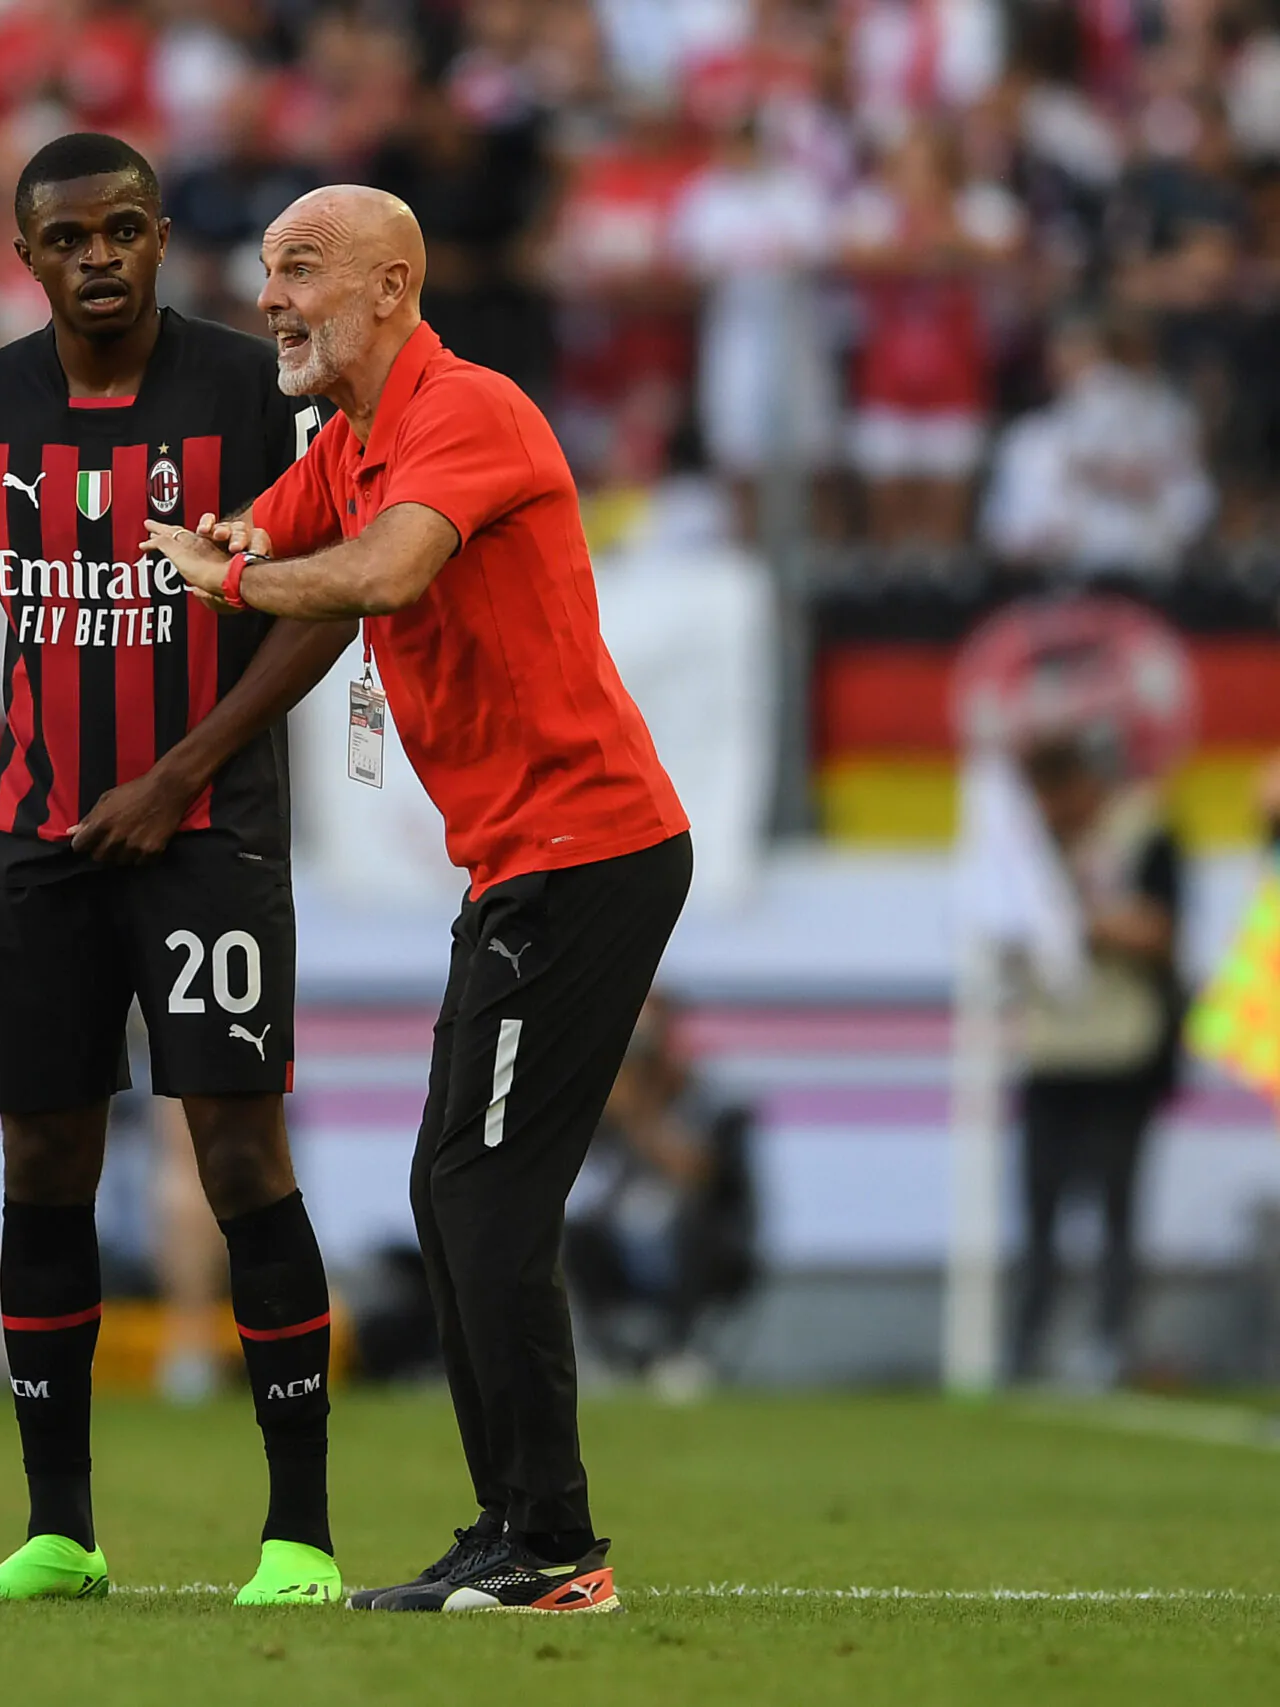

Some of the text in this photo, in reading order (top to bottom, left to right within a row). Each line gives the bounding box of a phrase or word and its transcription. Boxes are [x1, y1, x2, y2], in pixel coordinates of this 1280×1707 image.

[18, 604, 173, 647] FLY BETTER
[164, 929, 262, 1014] 20
[267, 1373, 321, 1400] ACM
